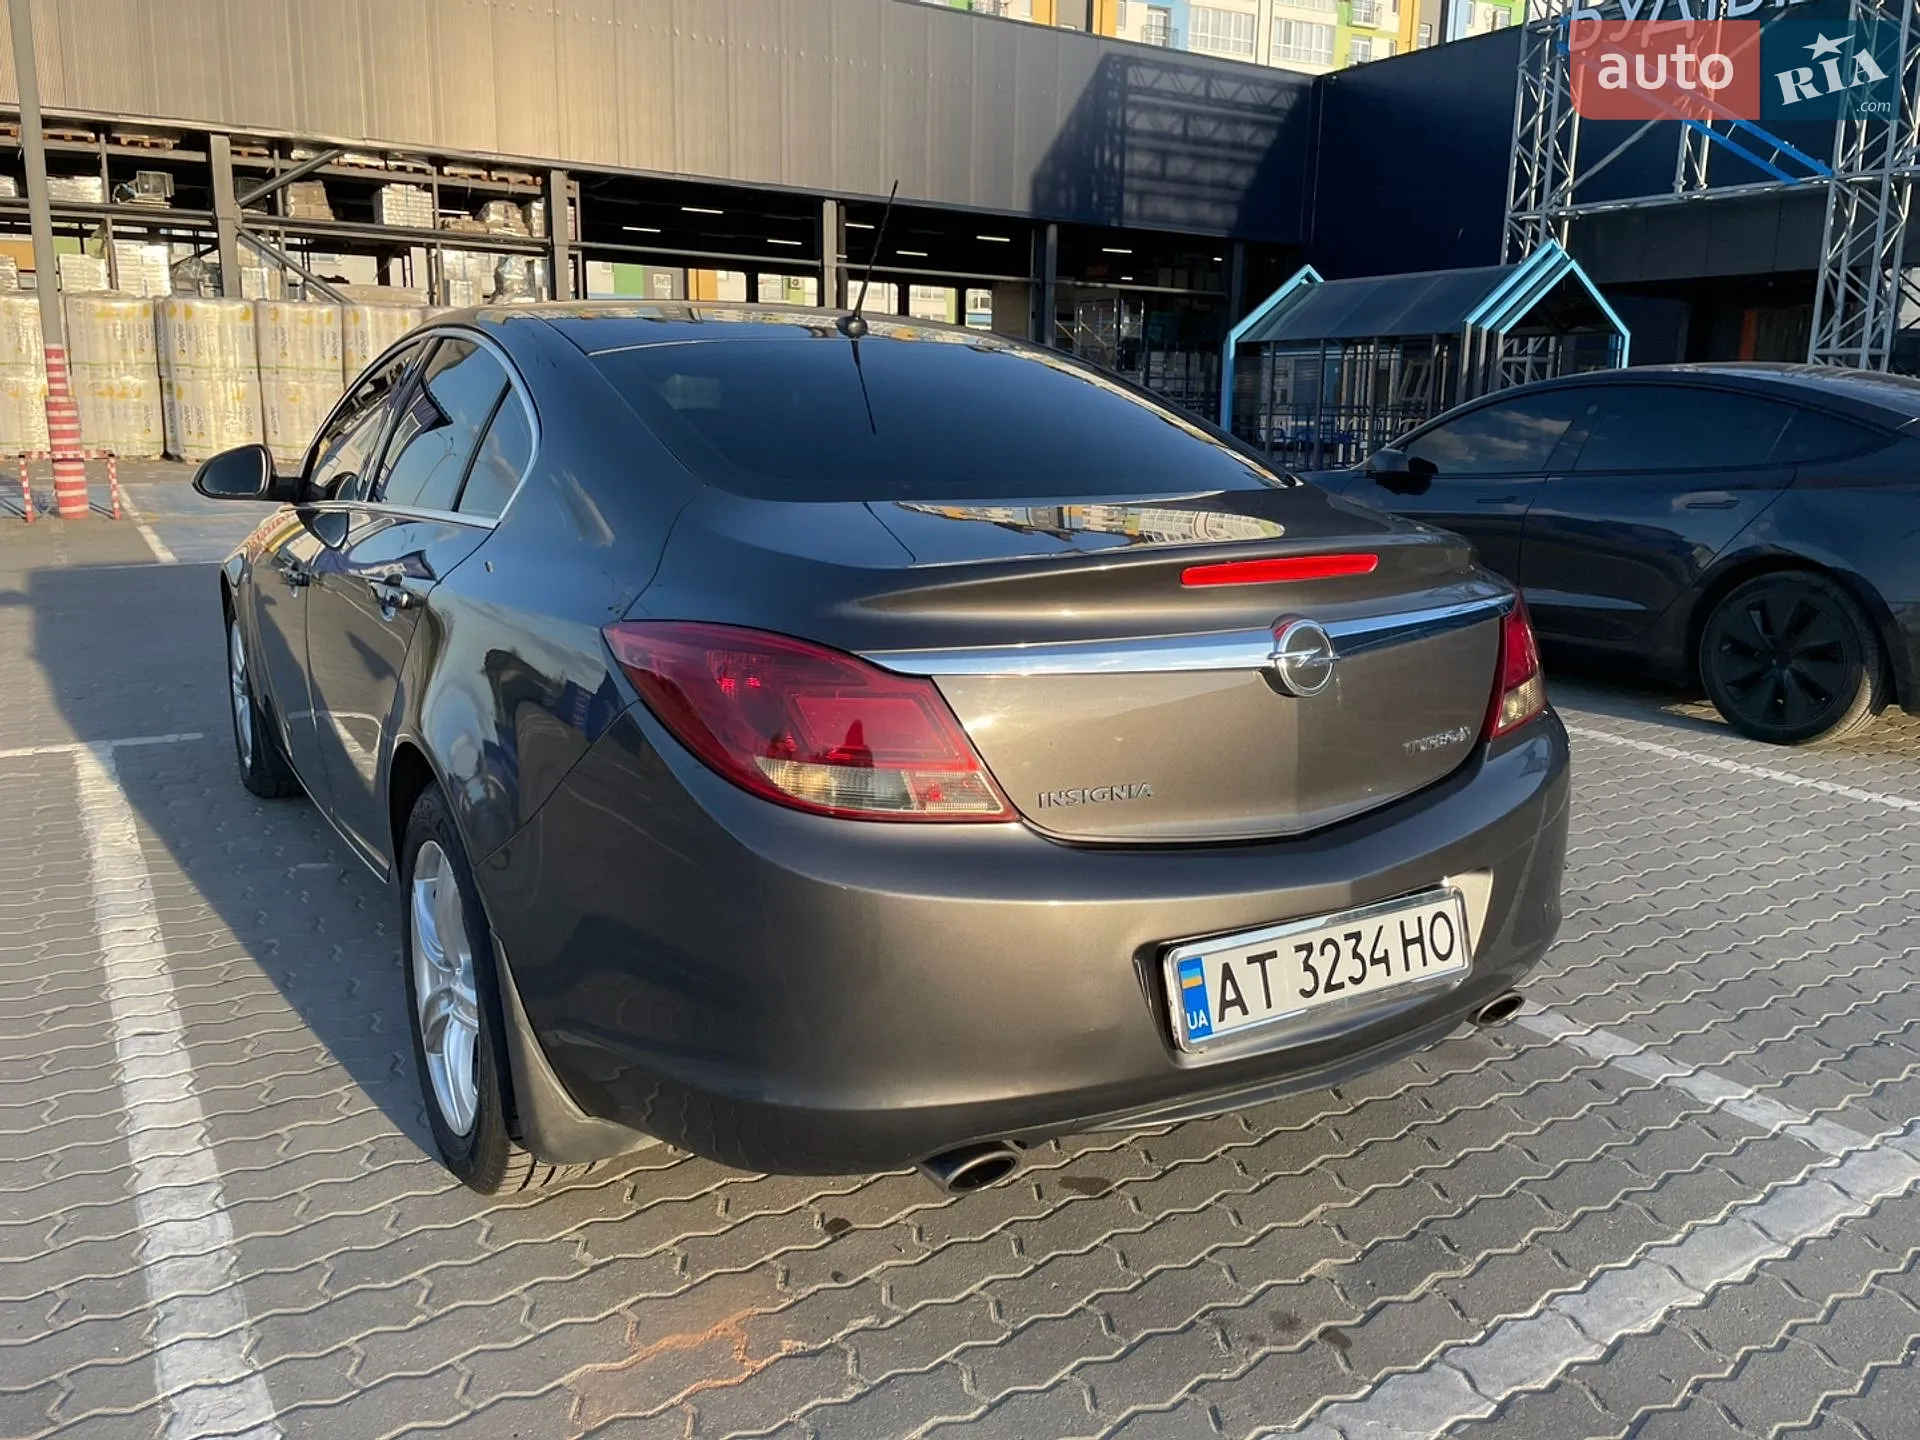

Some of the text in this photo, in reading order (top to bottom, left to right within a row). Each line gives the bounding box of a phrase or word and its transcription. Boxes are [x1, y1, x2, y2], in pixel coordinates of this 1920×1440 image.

[1038, 782, 1154, 808] INSIGNIA
[1217, 910, 1454, 1022] AT 3234 HO
[1186, 1009, 1209, 1031] UA
